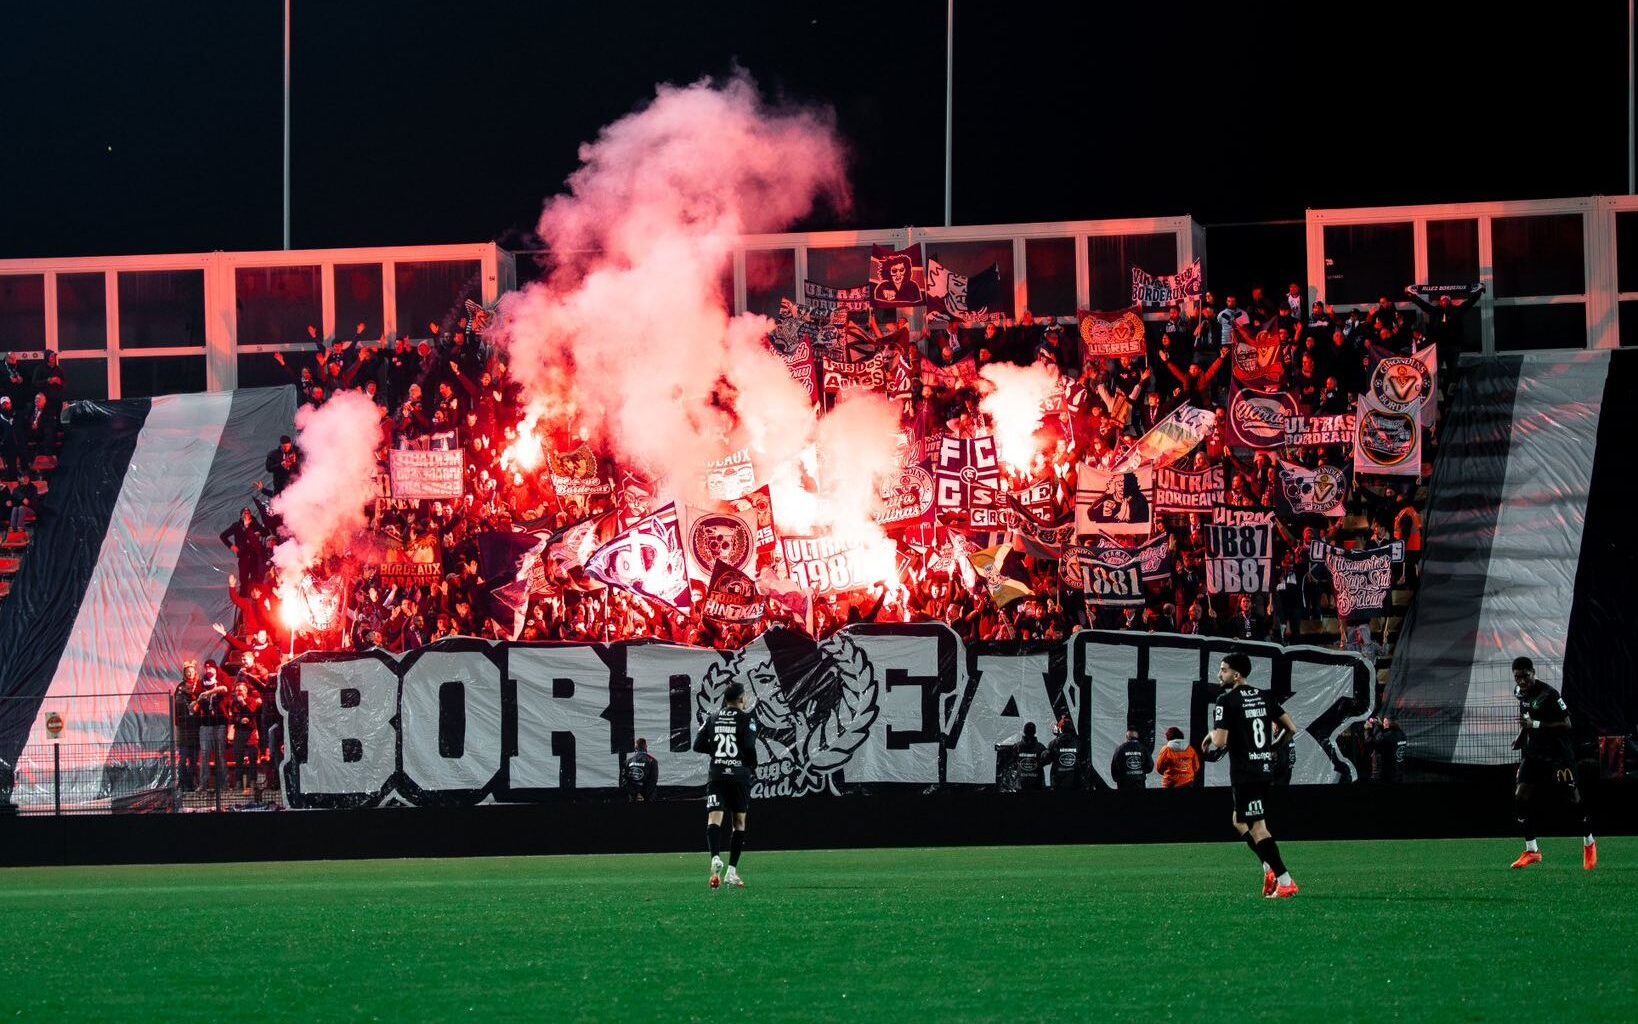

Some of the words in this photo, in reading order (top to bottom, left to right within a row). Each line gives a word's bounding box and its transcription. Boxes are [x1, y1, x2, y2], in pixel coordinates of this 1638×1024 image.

[1132, 285, 1187, 302] BORDEAUX
[1089, 340, 1140, 354] ULTRAS
[1284, 414, 1356, 434] ULTRAS
[1284, 430, 1355, 446] BORDEAU
[941, 437, 960, 467] F
[1157, 467, 1225, 493] ULTRAS
[1156, 489, 1226, 507] BORDEAUX
[1205, 526, 1268, 558] UB87
[380, 562, 441, 576] BORDEAUX
[1081, 566, 1141, 595] 1881
[1206, 558, 1272, 594] UB87
[381, 575, 440, 589] PARADISE
[298, 634, 1358, 797] BORDEAUX
[713, 733, 738, 758] 26
[1252, 718, 1265, 749] 8
